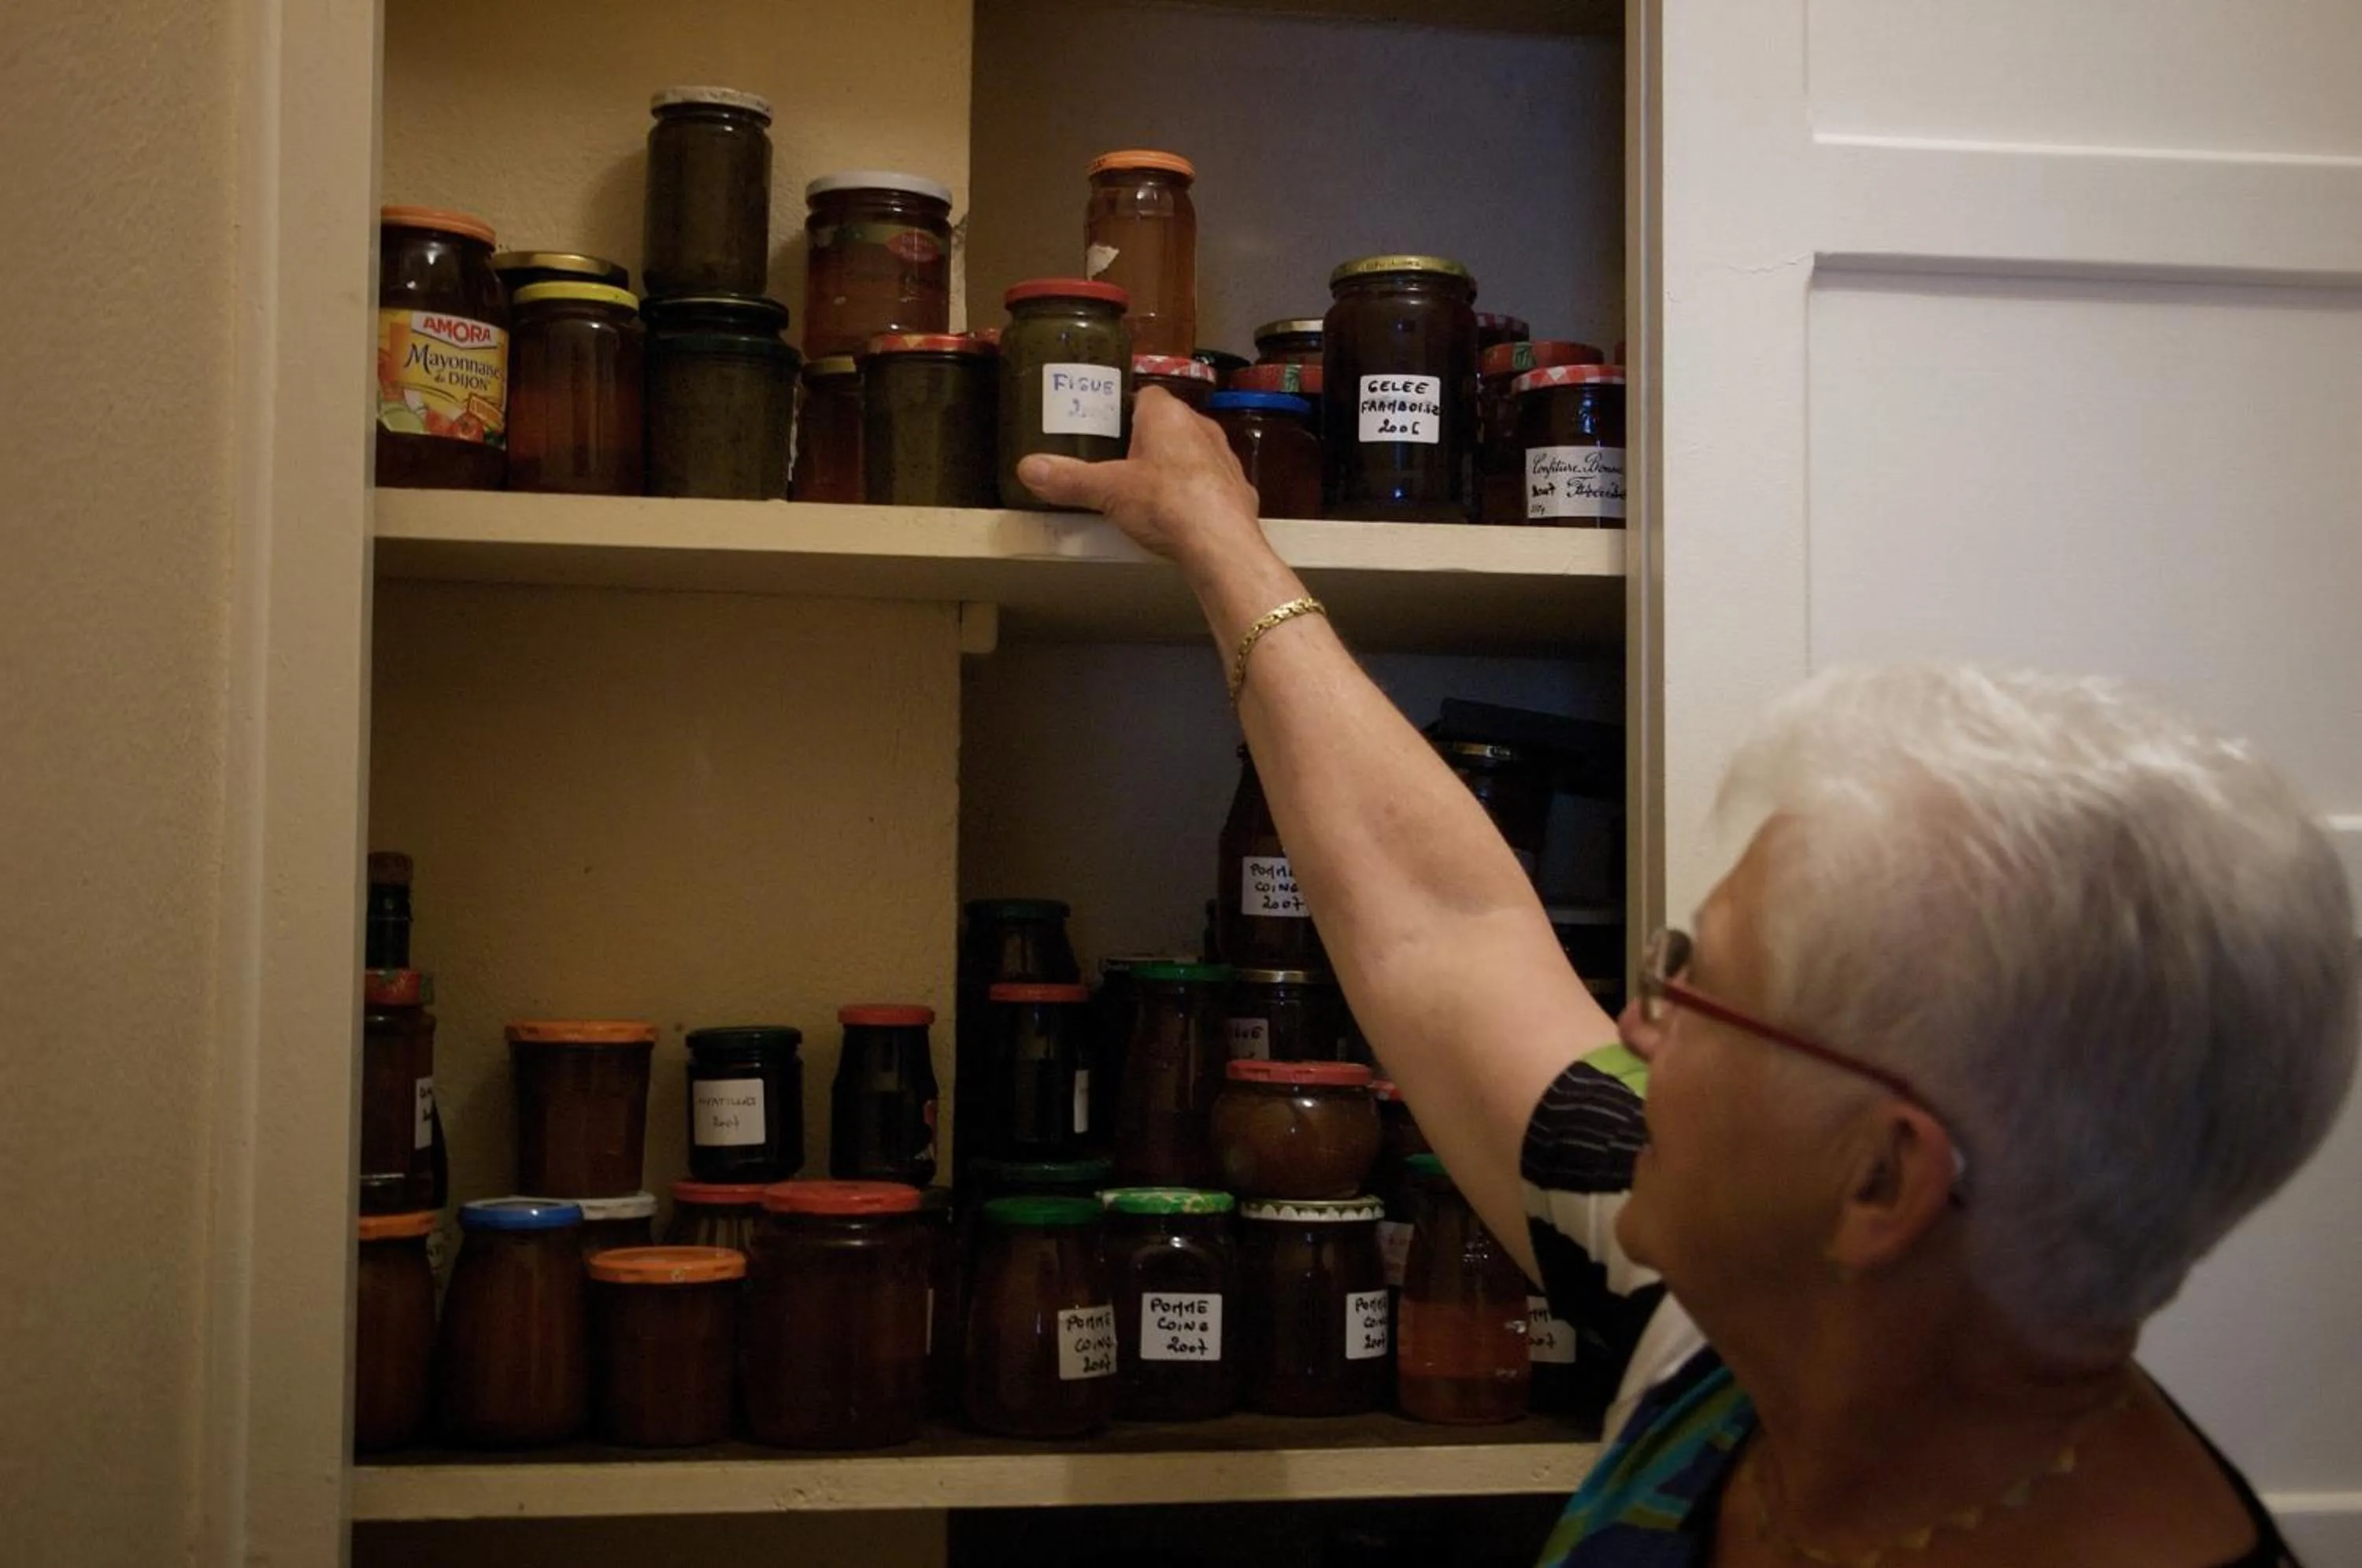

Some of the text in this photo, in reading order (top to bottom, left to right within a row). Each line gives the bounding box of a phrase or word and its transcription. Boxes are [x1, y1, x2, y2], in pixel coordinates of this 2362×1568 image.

[423, 316, 491, 343] AMORA
[449, 372, 488, 391] DIJON
[1053, 373, 1115, 395] FIGUE
[1368, 380, 1430, 394] GELEE
[1262, 895, 1305, 912] 2007
[1151, 1298, 1210, 1317] POMME
[1167, 1337, 1209, 1355] 2007
